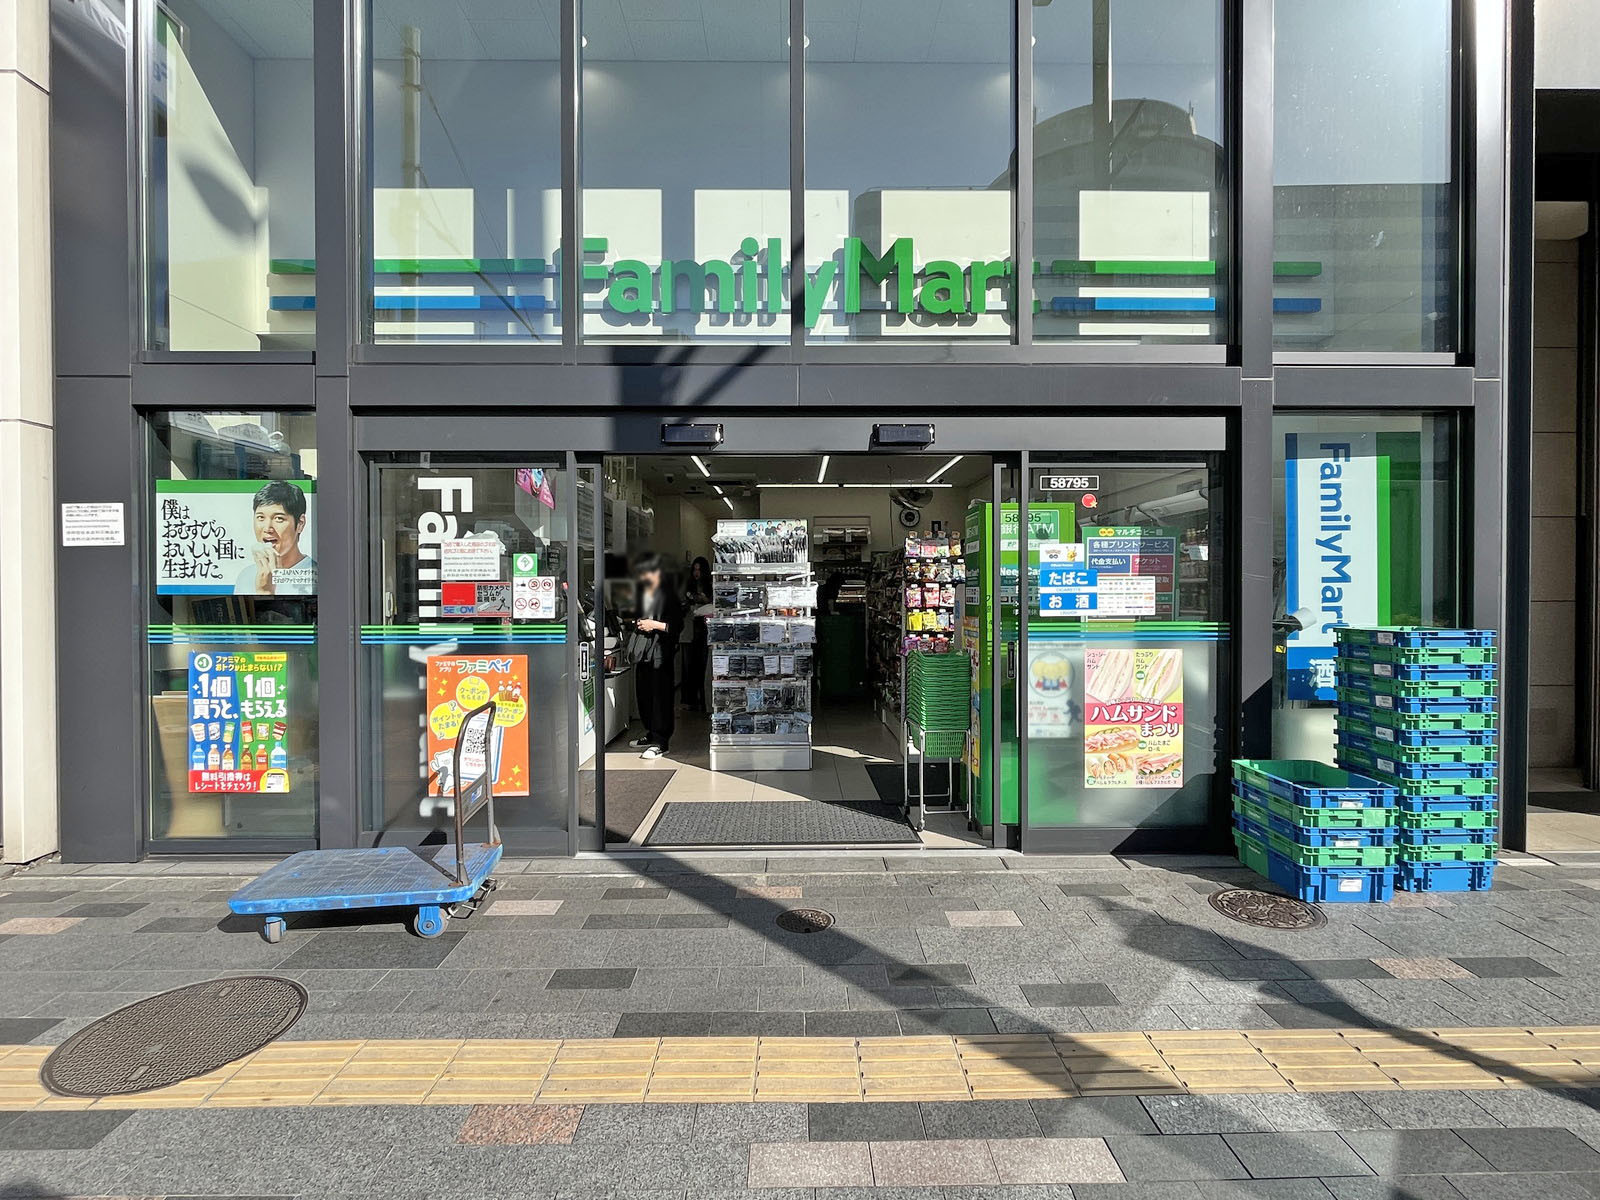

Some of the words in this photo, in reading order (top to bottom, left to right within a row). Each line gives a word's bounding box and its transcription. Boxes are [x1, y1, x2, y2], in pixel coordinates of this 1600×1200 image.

[1050, 477, 1089, 488] 58795
[161, 499, 190, 521] 僕は
[1005, 513, 1041, 523] 5895
[162, 520, 226, 539] おむすびの
[162, 539, 245, 560] おいしい国に
[1093, 540, 1170, 549] 各種プリントサービス
[161, 560, 224, 580] 生まれた。
[1091, 558, 1126, 566] 代金支払い
[1048, 571, 1089, 586] たばこ
[215, 655, 247, 664] ファミマの
[455, 658, 513, 674] ファミペイ
[240, 699, 287, 719] もらえる
[1090, 703, 1178, 724] ハムサンド
[1140, 722, 1180, 738] まつり
